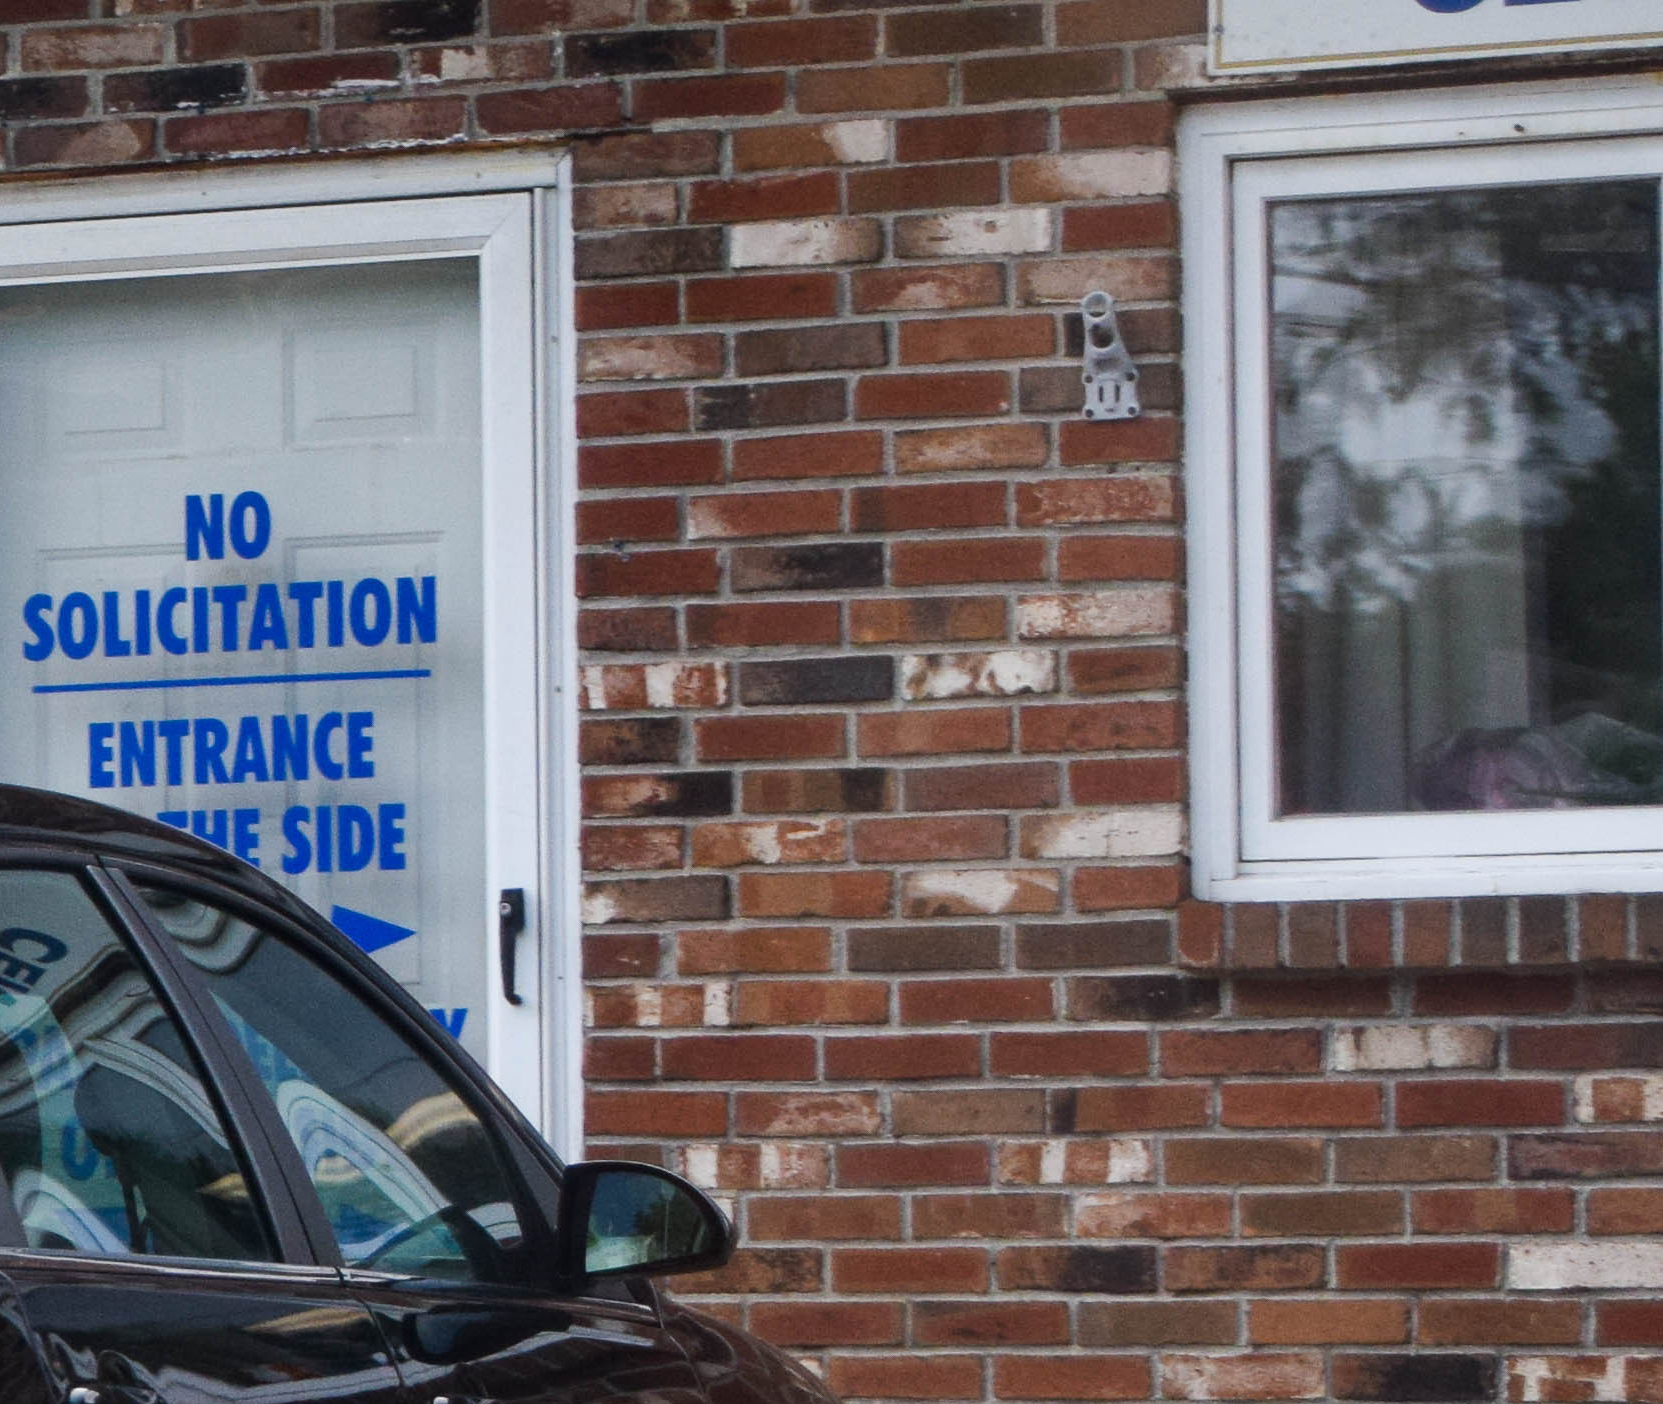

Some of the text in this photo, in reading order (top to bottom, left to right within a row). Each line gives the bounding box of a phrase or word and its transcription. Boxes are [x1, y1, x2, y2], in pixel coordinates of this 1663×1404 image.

[184, 490, 272, 562] NO
[22, 575, 438, 662] SOLICITATION
[88, 711, 377, 789] ENTRANCE
[281, 803, 406, 875] SIDE
